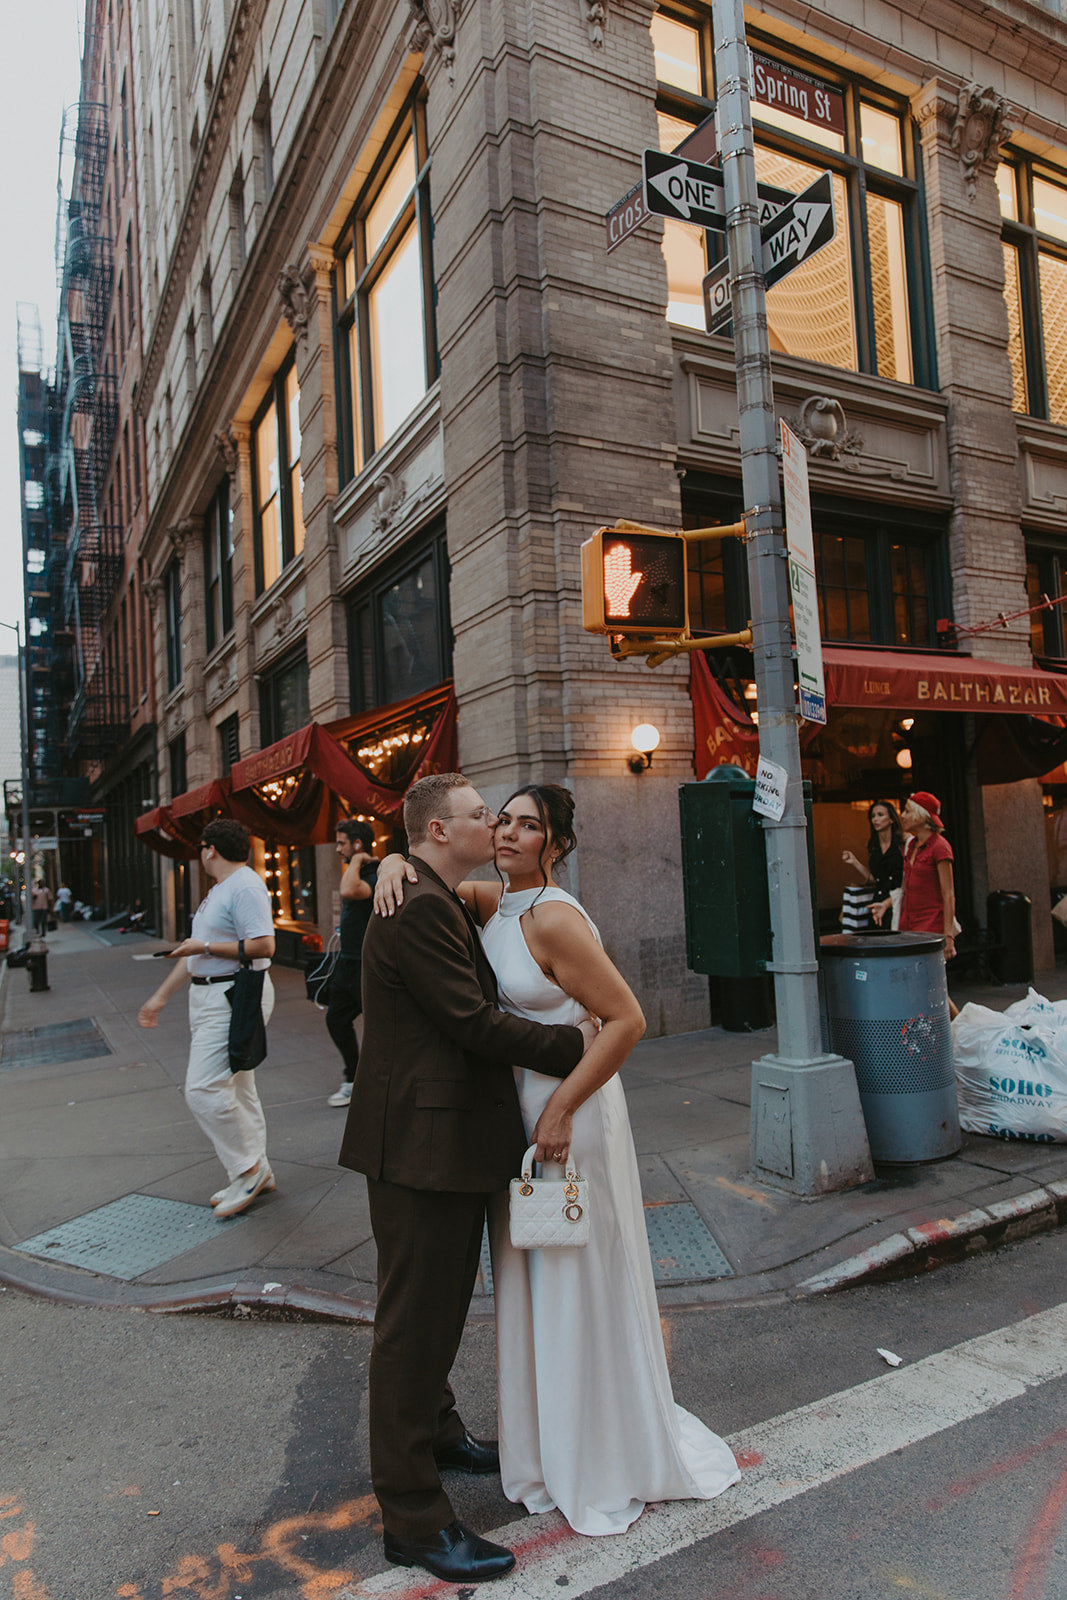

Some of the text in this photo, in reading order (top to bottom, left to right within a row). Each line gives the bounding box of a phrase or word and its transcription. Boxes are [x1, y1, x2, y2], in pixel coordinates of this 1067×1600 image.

[755, 65, 832, 121] Spring St
[668, 176, 716, 210] ONE
[610, 198, 645, 242] Cros
[769, 208, 812, 263] WAY
[792, 564, 799, 591] 2
[864, 680, 891, 695] LUNCH
[917, 680, 1051, 705] BALTHAZAR
[761, 770, 773, 780] NO
[989, 1076, 1053, 1098] SOHO
[990, 1094, 1053, 1108] BROADWAY
